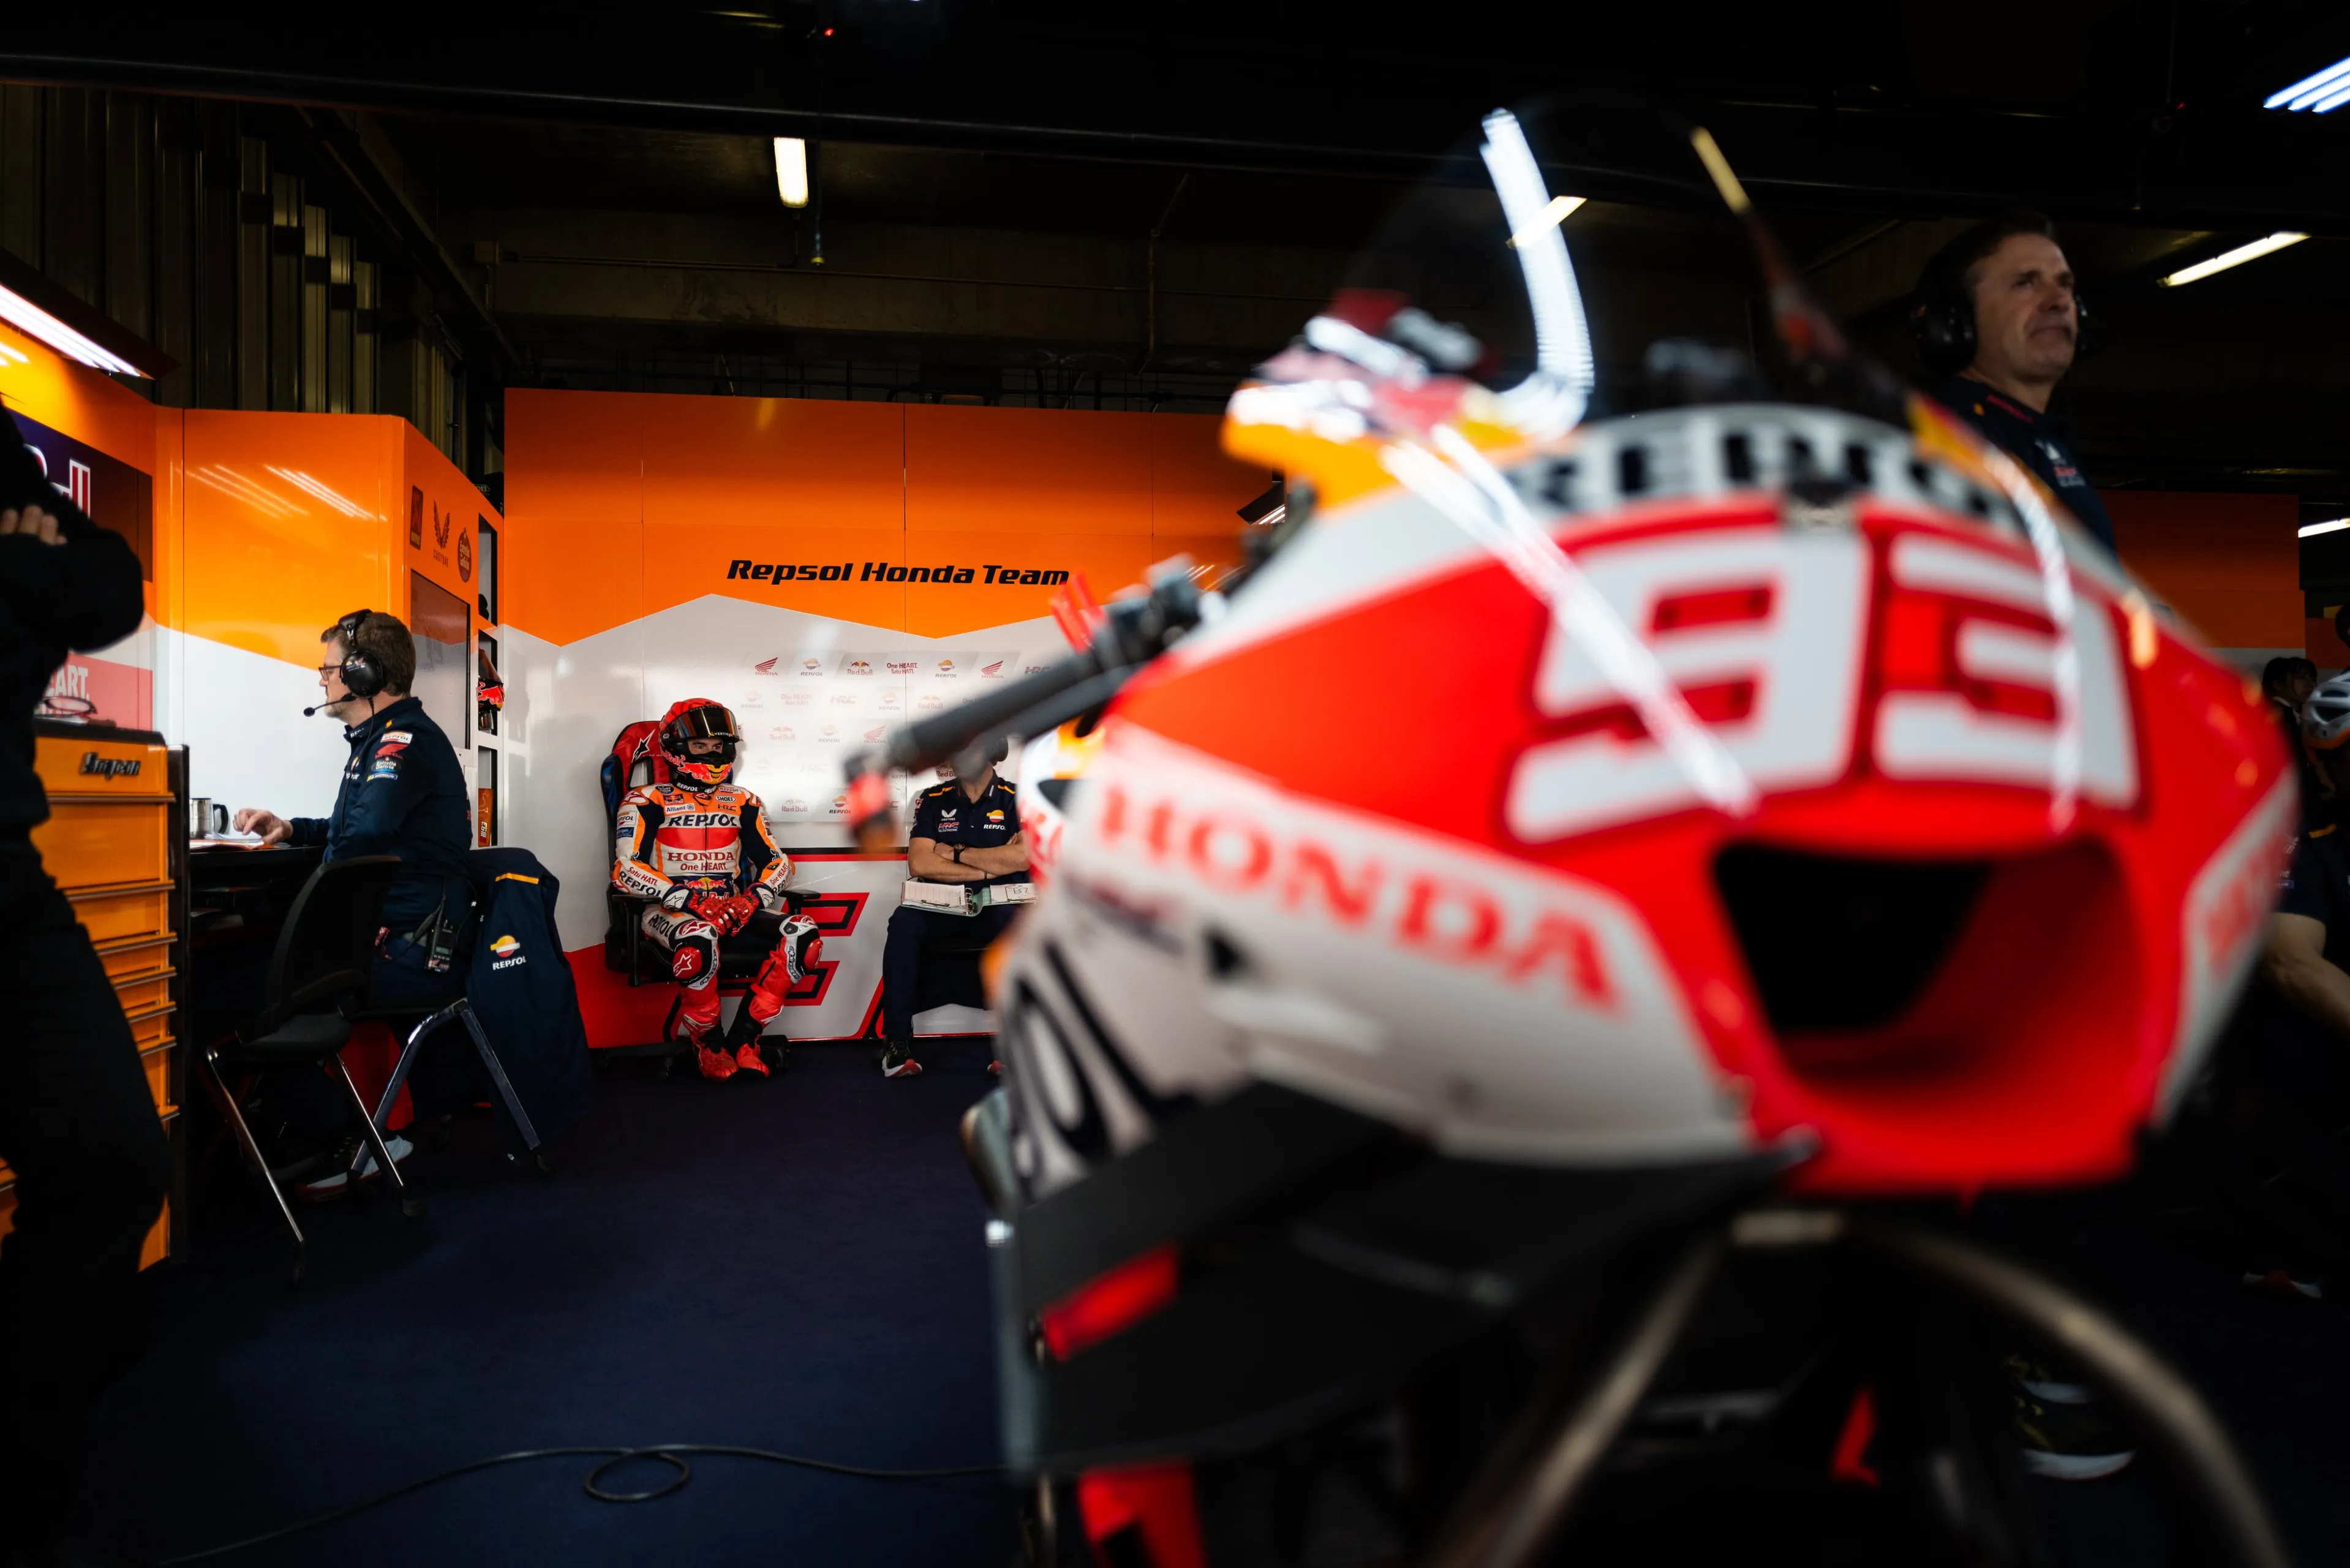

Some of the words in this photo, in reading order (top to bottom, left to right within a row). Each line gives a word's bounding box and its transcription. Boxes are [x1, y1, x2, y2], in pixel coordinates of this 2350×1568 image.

[726, 560, 854, 586] Repsol
[860, 562, 976, 584] Honda
[983, 565, 1070, 586] Team
[1505, 532, 2137, 845] 93
[676, 782, 698, 792] REPSOL
[667, 851, 735, 862] HONDA
[701, 862, 728, 871] HEART.
[619, 870, 661, 897] REPSOL
[627, 867, 641, 878] Satu
[640, 874, 658, 886] HATI.
[770, 875, 779, 886] One
[1102, 785, 1624, 1019] HONDA
[492, 955, 527, 971] REPSOL
